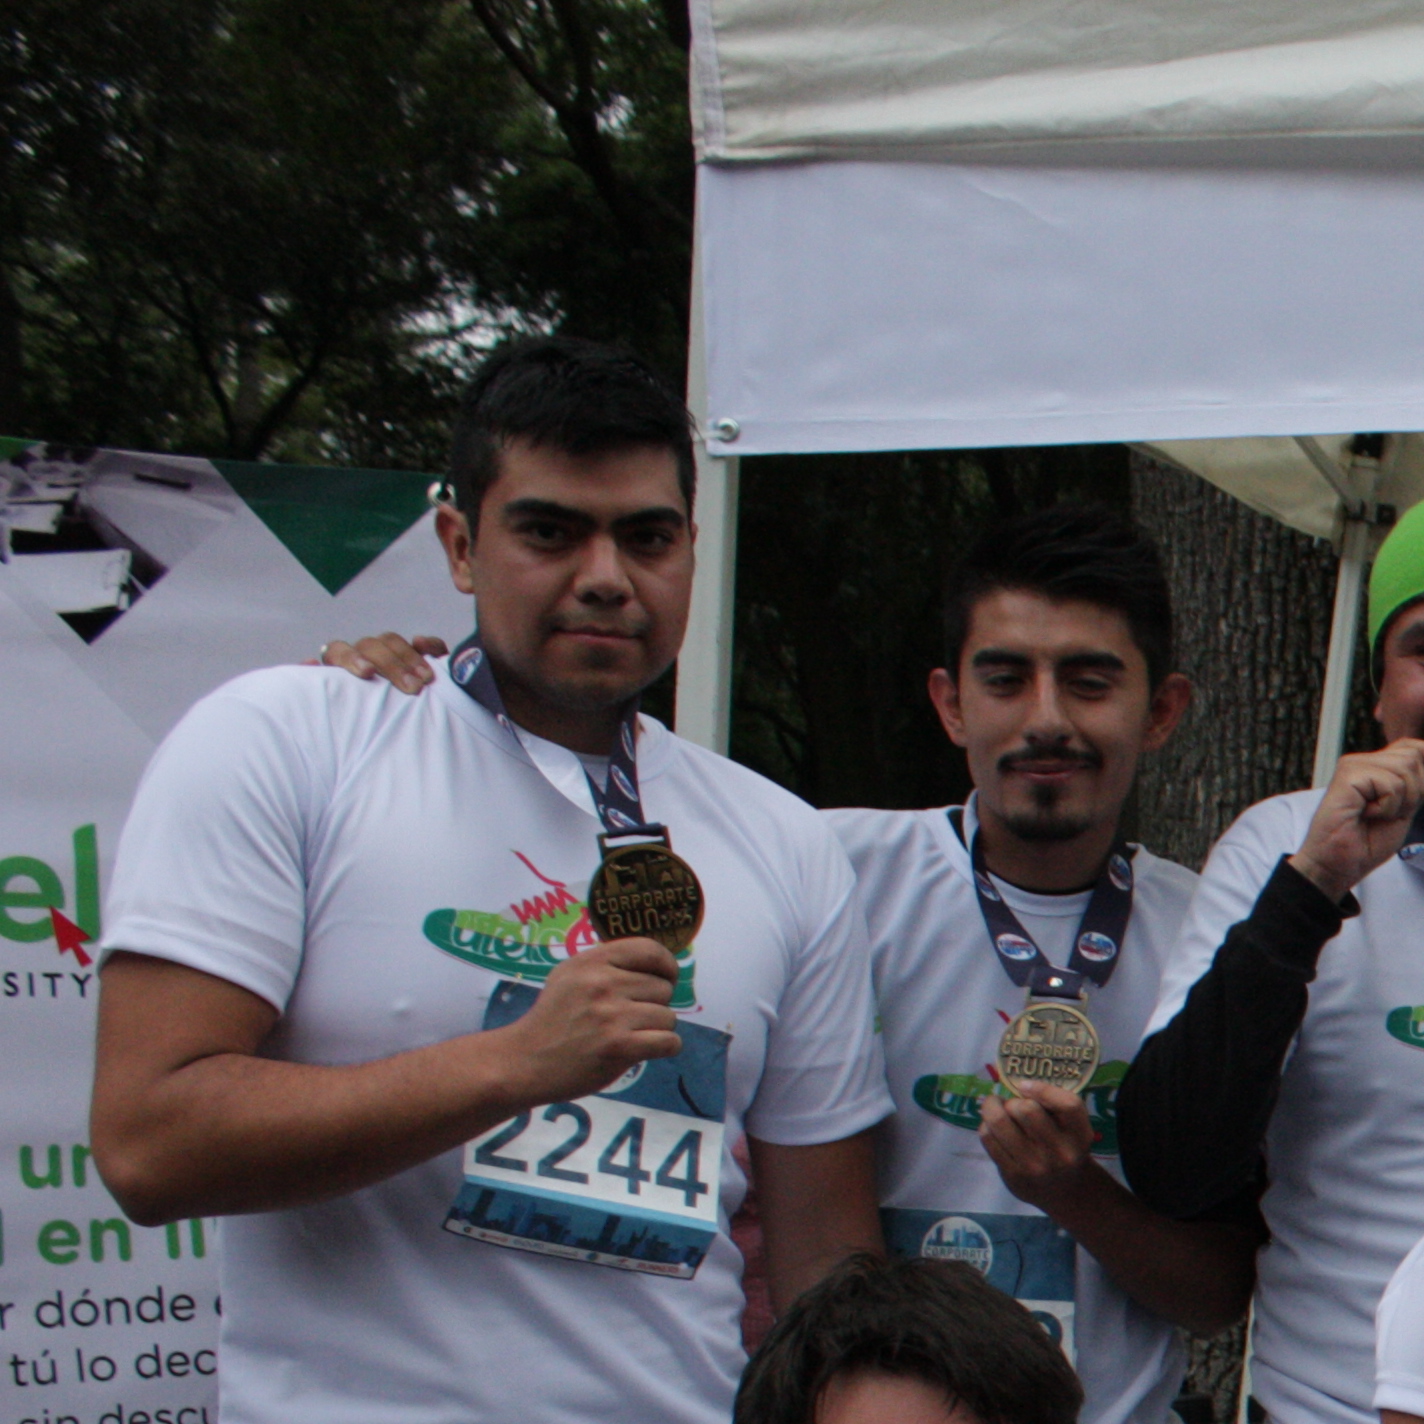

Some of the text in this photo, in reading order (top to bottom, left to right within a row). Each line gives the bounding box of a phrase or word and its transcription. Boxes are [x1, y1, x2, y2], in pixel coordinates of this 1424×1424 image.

[597, 885, 697, 915] CORPORATE
[608, 908, 660, 936] RUN
[4, 972, 92, 998] SITY
[1001, 1041, 1092, 1061] CORPORATE
[1007, 1056, 1053, 1078] RUN
[475, 1103, 708, 1207] 2244
[37, 1217, 132, 1265] en
[35, 1285, 196, 1328] dónde
[10, 1350, 58, 1386] tú
[76, 1348, 117, 1382] lo
